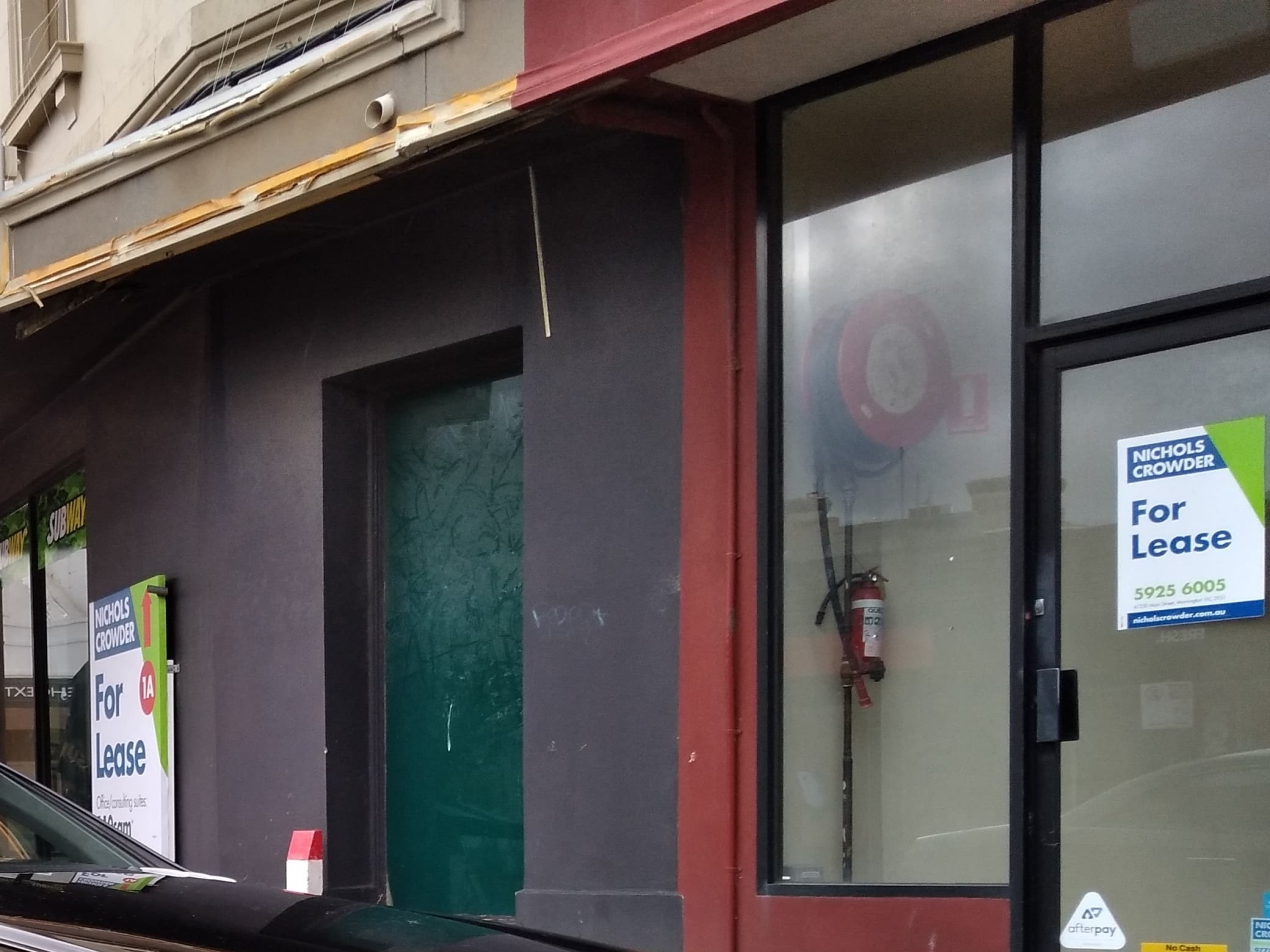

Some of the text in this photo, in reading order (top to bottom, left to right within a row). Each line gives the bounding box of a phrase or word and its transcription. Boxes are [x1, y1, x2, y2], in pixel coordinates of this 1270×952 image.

[1133, 440, 1205, 463] NICHOLS
[1133, 455, 1214, 478] CROWDER
[1132, 499, 1186, 525] For
[1132, 530, 1232, 559] Lease
[1134, 579, 1225, 600] 5925 6005
[95, 596, 129, 628] NICHOLS
[1133, 609, 1226, 624] nicholscrowder.com.au
[96, 621, 135, 652] CROWDER
[96, 673, 123, 722] For
[142, 675, 155, 700] 1A
[96, 733, 146, 778] Lease
[1068, 923, 1116, 937] afterpay
